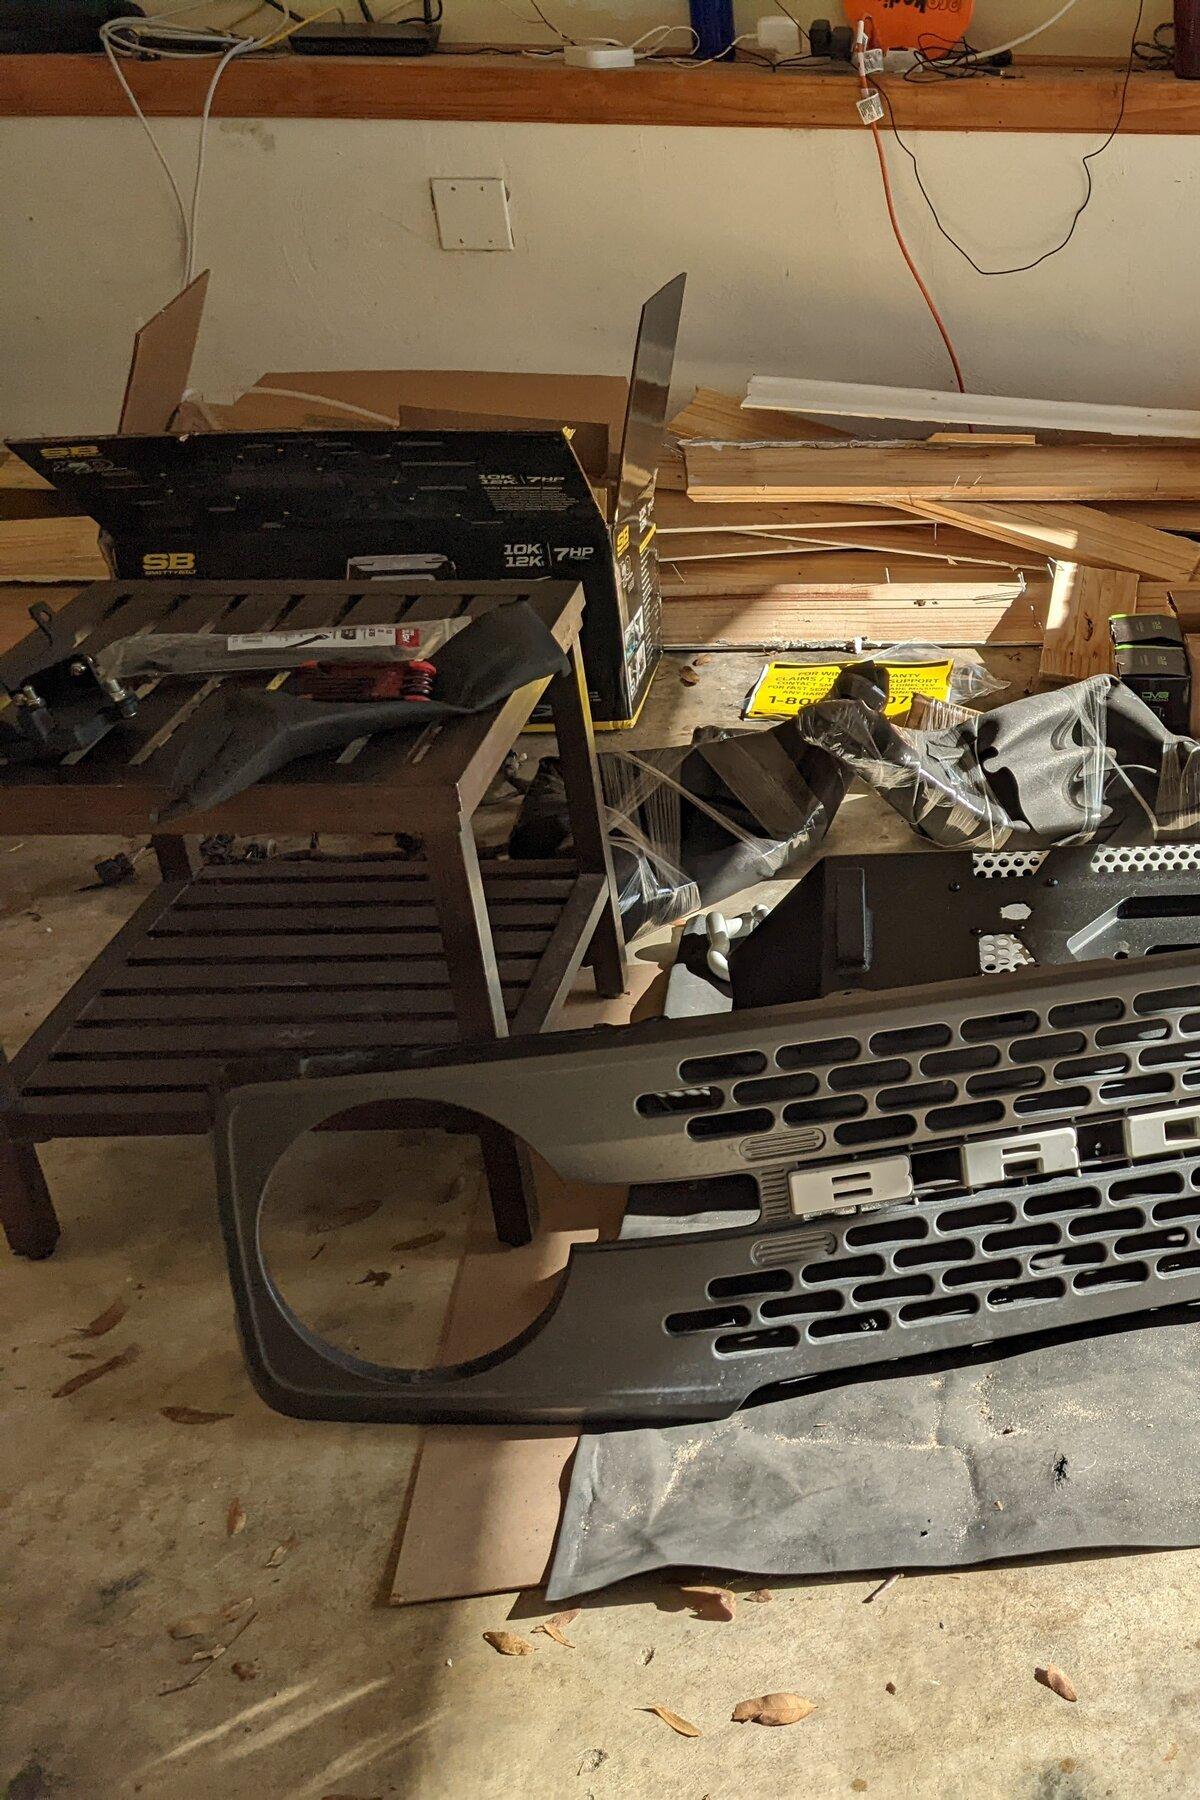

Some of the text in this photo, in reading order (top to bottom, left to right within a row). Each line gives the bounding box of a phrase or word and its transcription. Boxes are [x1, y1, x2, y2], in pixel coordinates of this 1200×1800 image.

[504, 543, 595, 561] 10K 7HP
[142, 553, 196, 570] SB
[505, 555, 544, 568] 12K
